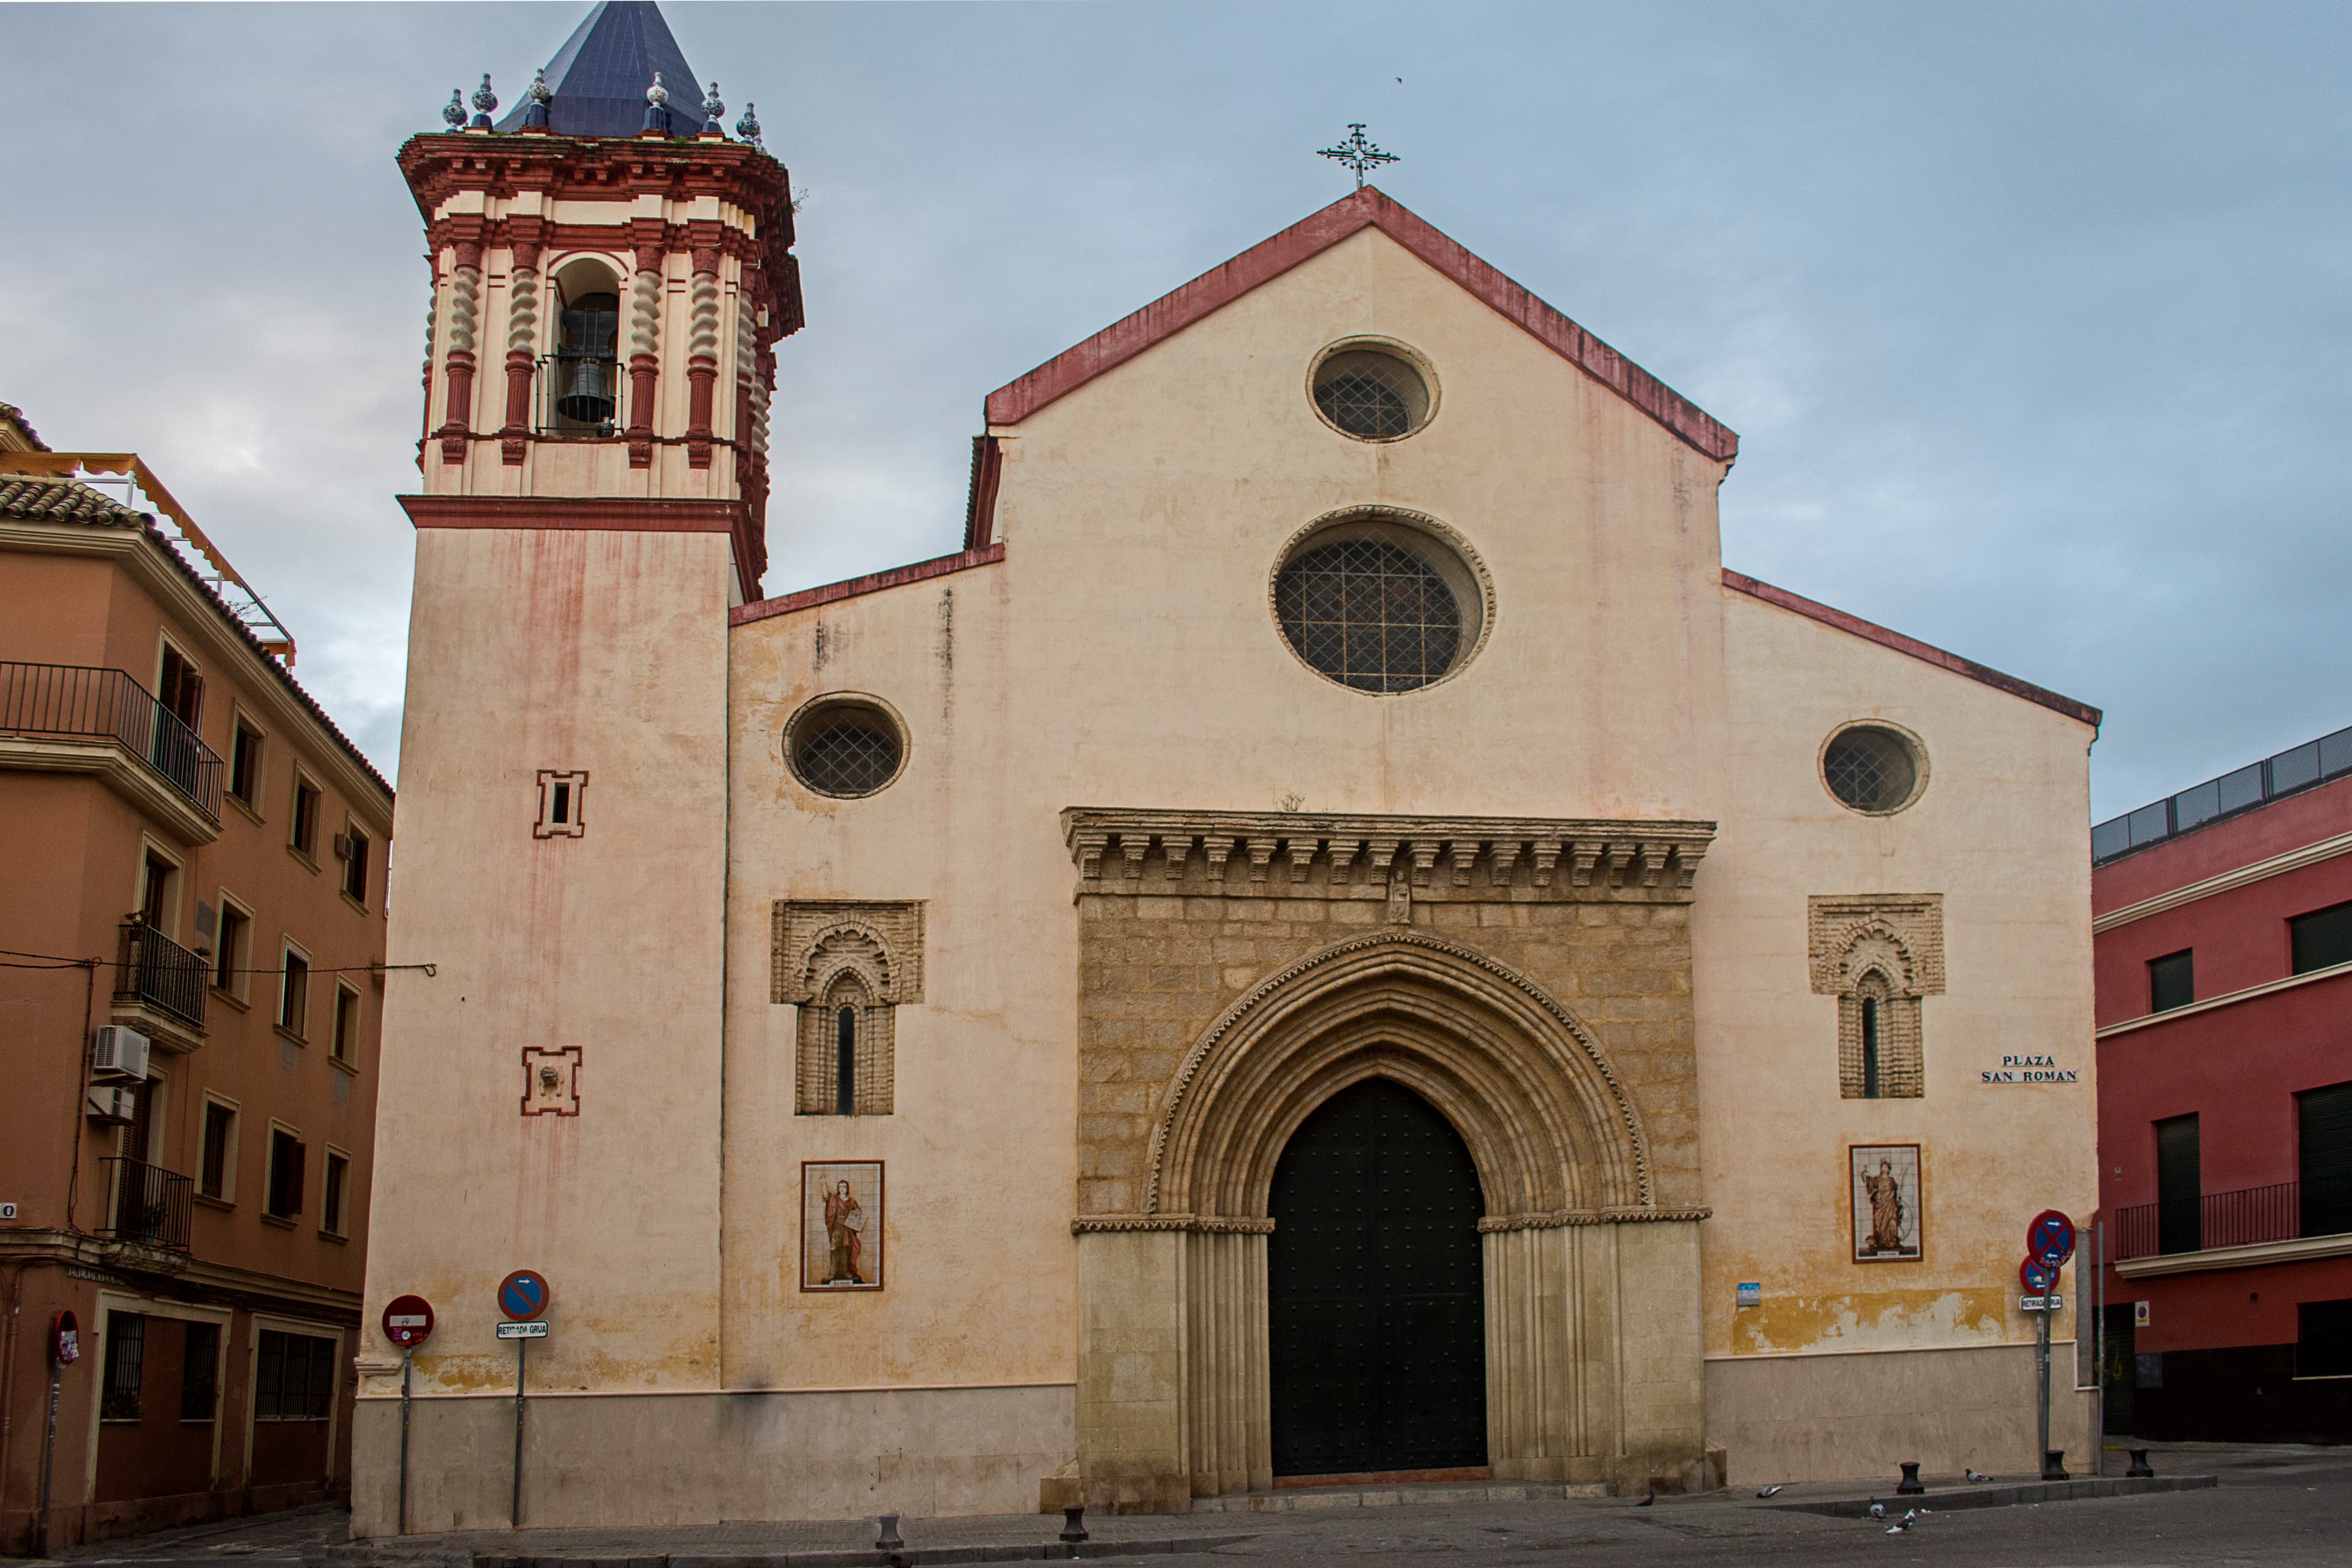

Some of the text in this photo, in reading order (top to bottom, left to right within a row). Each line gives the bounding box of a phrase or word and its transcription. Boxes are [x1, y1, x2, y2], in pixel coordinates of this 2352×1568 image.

[2003, 1055, 2054, 1066] PLAZA
[1981, 1071, 2076, 1082] SAN ROMAN
[530, 1325, 546, 1333] GRUA
